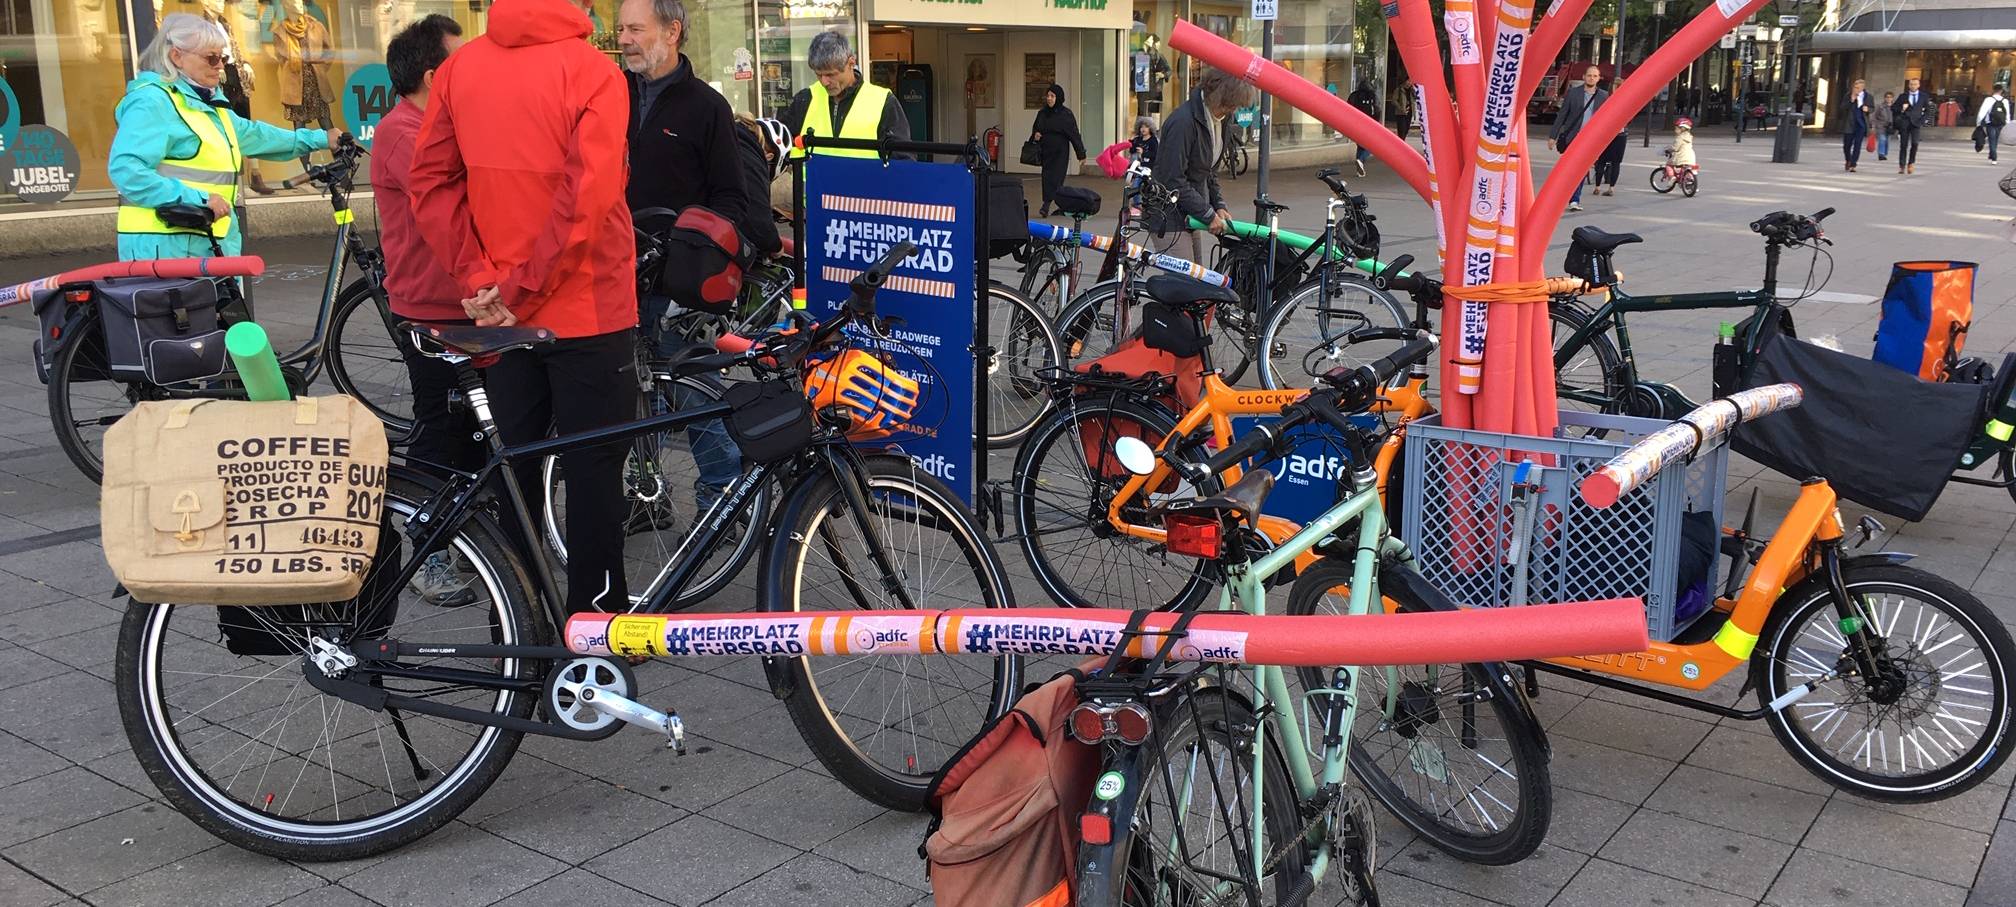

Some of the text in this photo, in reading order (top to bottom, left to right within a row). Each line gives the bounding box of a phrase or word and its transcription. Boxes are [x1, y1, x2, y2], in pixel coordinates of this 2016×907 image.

[1496, 33, 1524, 118] FÜRSRAD
[10, 166, 75, 186] JUBEL-
[18, 184, 70, 194] ANGEBOTE!
[1478, 176, 1489, 200] adfc
[849, 239, 954, 273] FÜRRAD
[895, 329, 941, 346] RADWEGE
[1237, 394, 1295, 405] CLOCKW
[217, 437, 350, 459] COFFEE
[217, 460, 342, 475] PRODUCTO DE
[318, 473, 343, 484] OF
[1288, 474, 1309, 486] Essen
[226, 486, 330, 506] COSECHA
[214, 558, 262, 573] 150
[272, 556, 331, 573] LBS.
[876, 629, 908, 641] adfc
[1203, 646, 1239, 659] adfc
[1099, 780, 1119, 792] 25%
